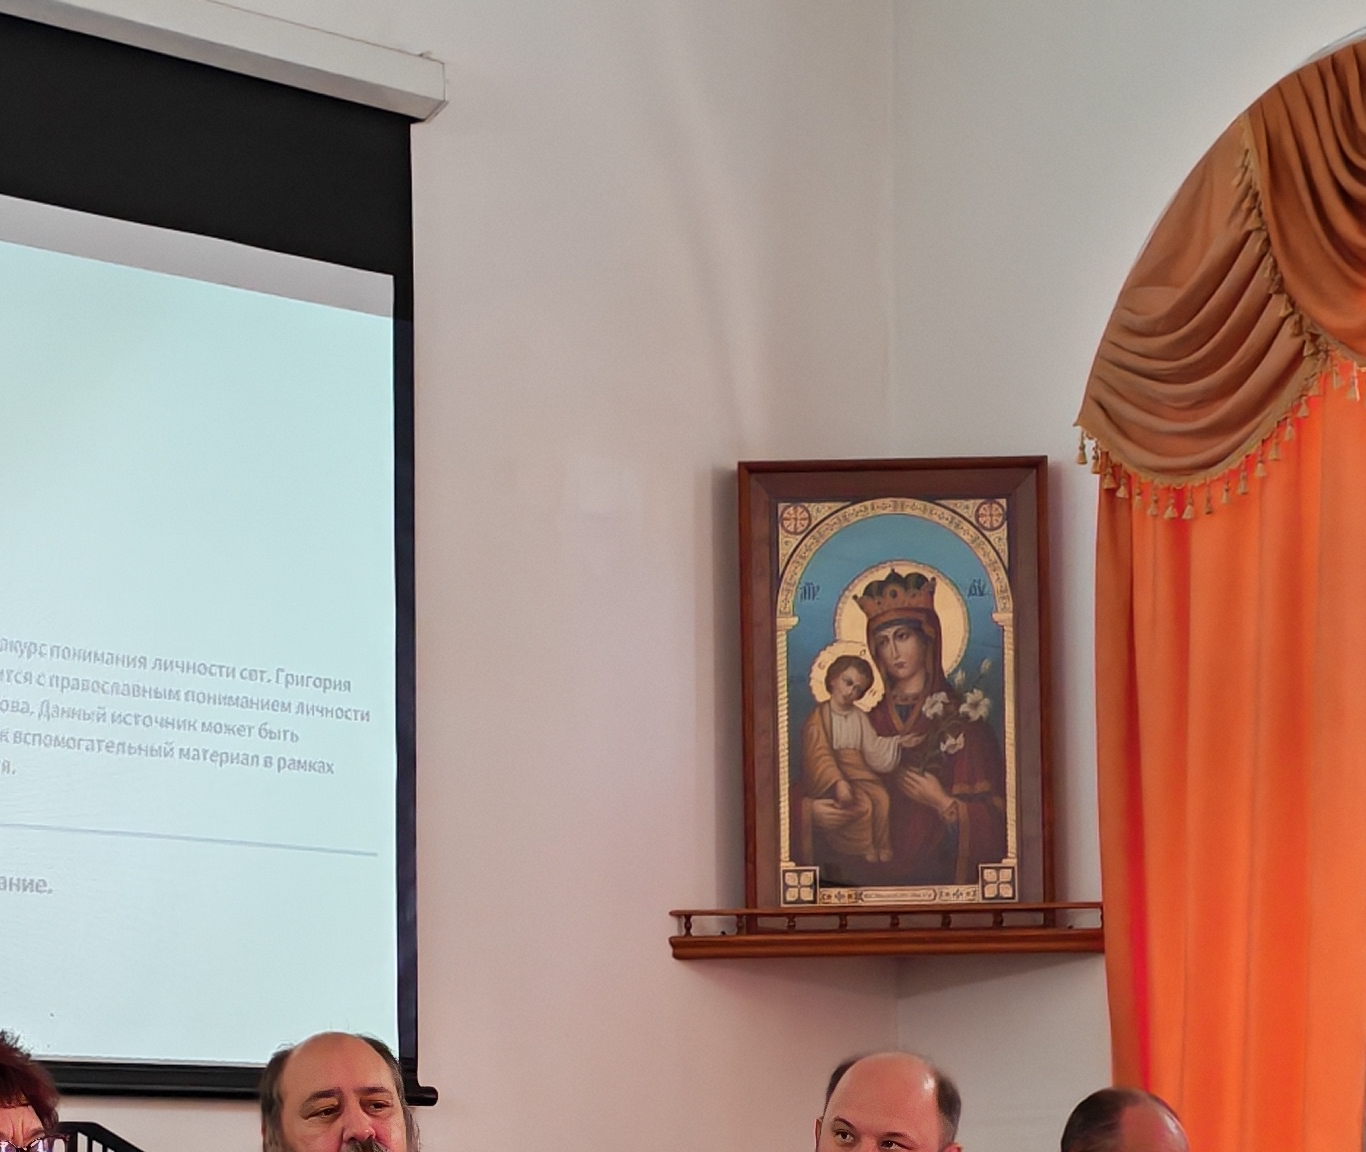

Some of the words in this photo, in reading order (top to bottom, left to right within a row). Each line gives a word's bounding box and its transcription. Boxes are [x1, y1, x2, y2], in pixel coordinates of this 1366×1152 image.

[50, 643, 148, 671] понимания
[151, 655, 236, 680] личности
[275, 667, 352, 694] Григория
[35, 673, 46, 687] с
[48, 674, 181, 702] православным
[184, 689, 292, 714] пониманием
[295, 700, 371, 723] личности
[37, 699, 107, 726] Данный
[110, 710, 198, 732] источник
[201, 720, 254, 738] может
[258, 721, 299, 744] быть
[13, 730, 174, 759] вспомогательный
[178, 745, 259, 768] материал
[263, 755, 273, 769] в
[276, 756, 335, 775] рамках
